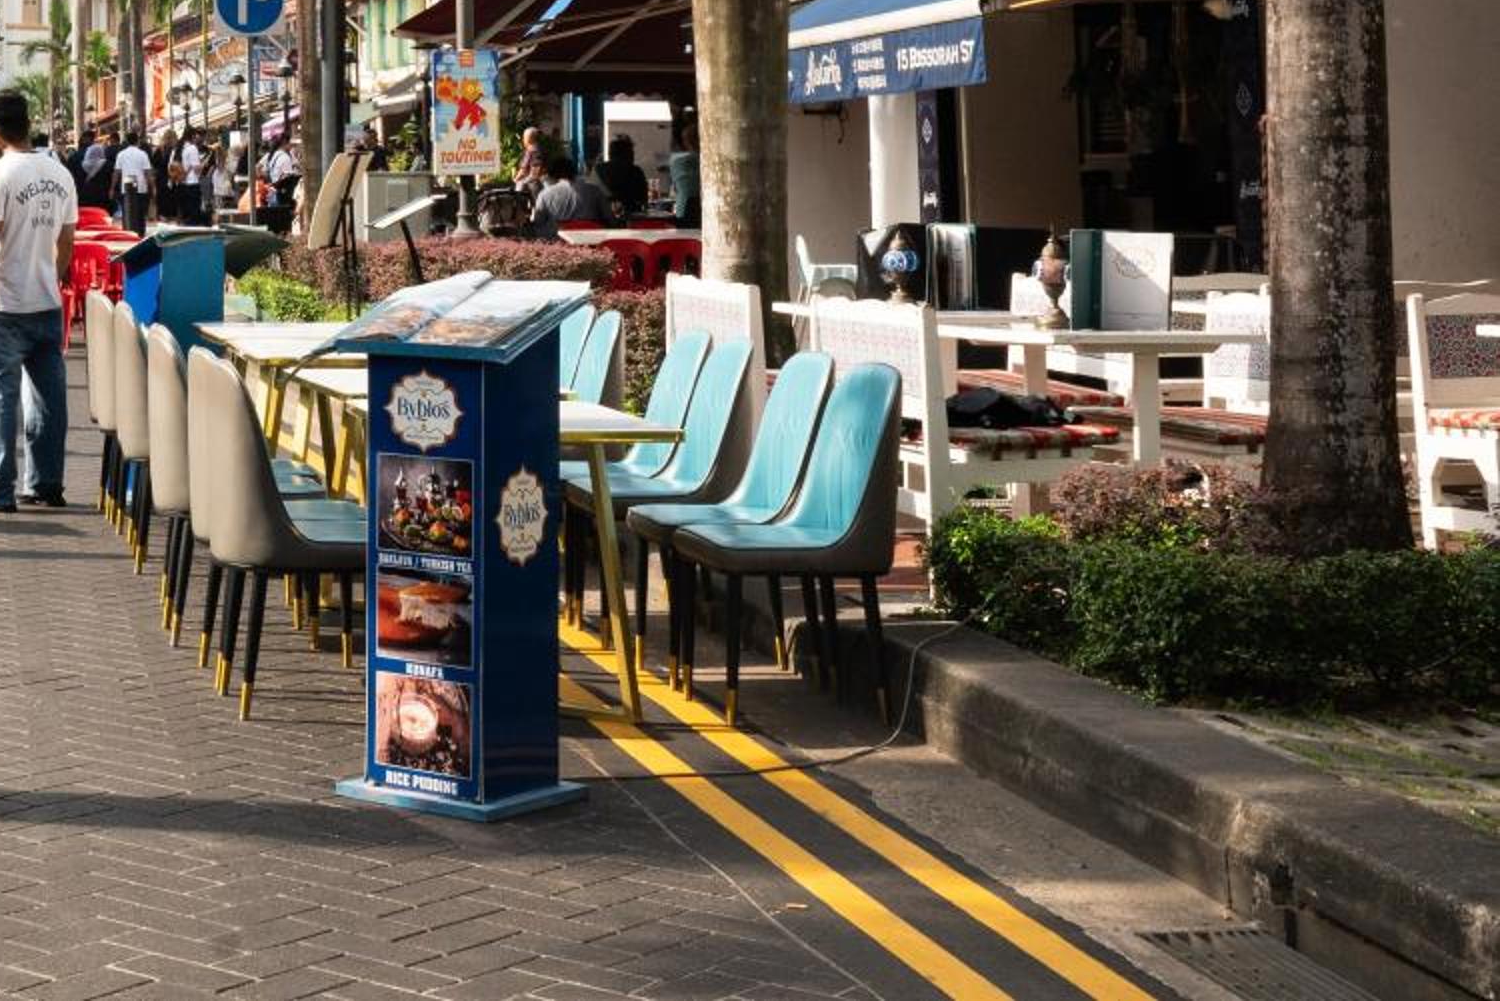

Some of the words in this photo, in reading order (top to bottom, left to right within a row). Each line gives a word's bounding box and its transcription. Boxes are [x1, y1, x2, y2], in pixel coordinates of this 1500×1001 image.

[896, 48, 909, 72] 15
[960, 40, 975, 63] ST
[458, 138, 477, 151] NO
[385, 769, 410, 787] RICE
